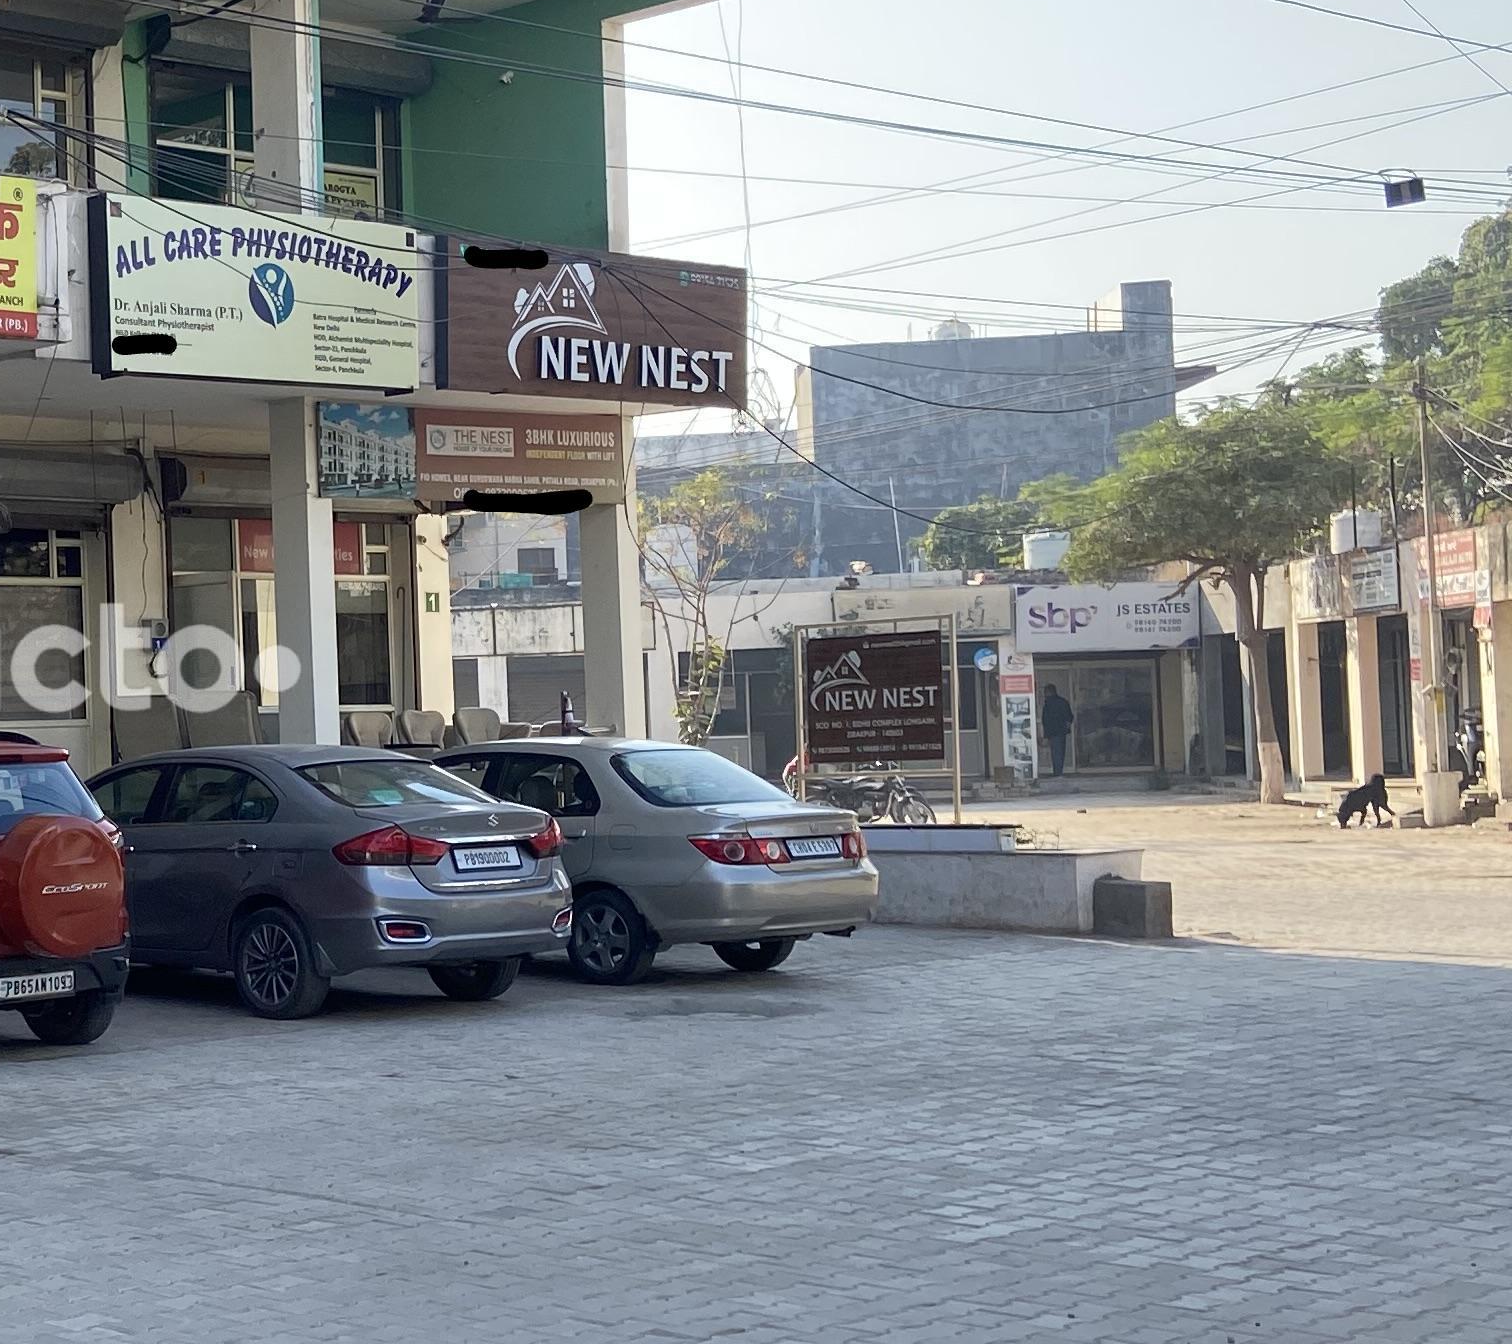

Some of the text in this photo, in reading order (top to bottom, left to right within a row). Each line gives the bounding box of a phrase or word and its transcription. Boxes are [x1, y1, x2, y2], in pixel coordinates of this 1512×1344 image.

[115, 227, 413, 298] ALL CARE PHYSIOTHERAPY
[114, 298, 131, 311] Dr.
[134, 300, 167, 316] Anjali
[170, 303, 212, 318] Sharma
[114, 316, 215, 332] Consultant Physiotherapist
[539, 335, 733, 394] NEW NEST
[453, 429, 513, 445] THE NEST
[525, 429, 615, 448] 3BHK LUXURIOUS
[587, 452, 602, 461] WITH
[244, 545, 268, 559] New
[1029, 602, 1191, 634] sbp JS ESTATES
[825, 686, 938, 712] NEW NEST
